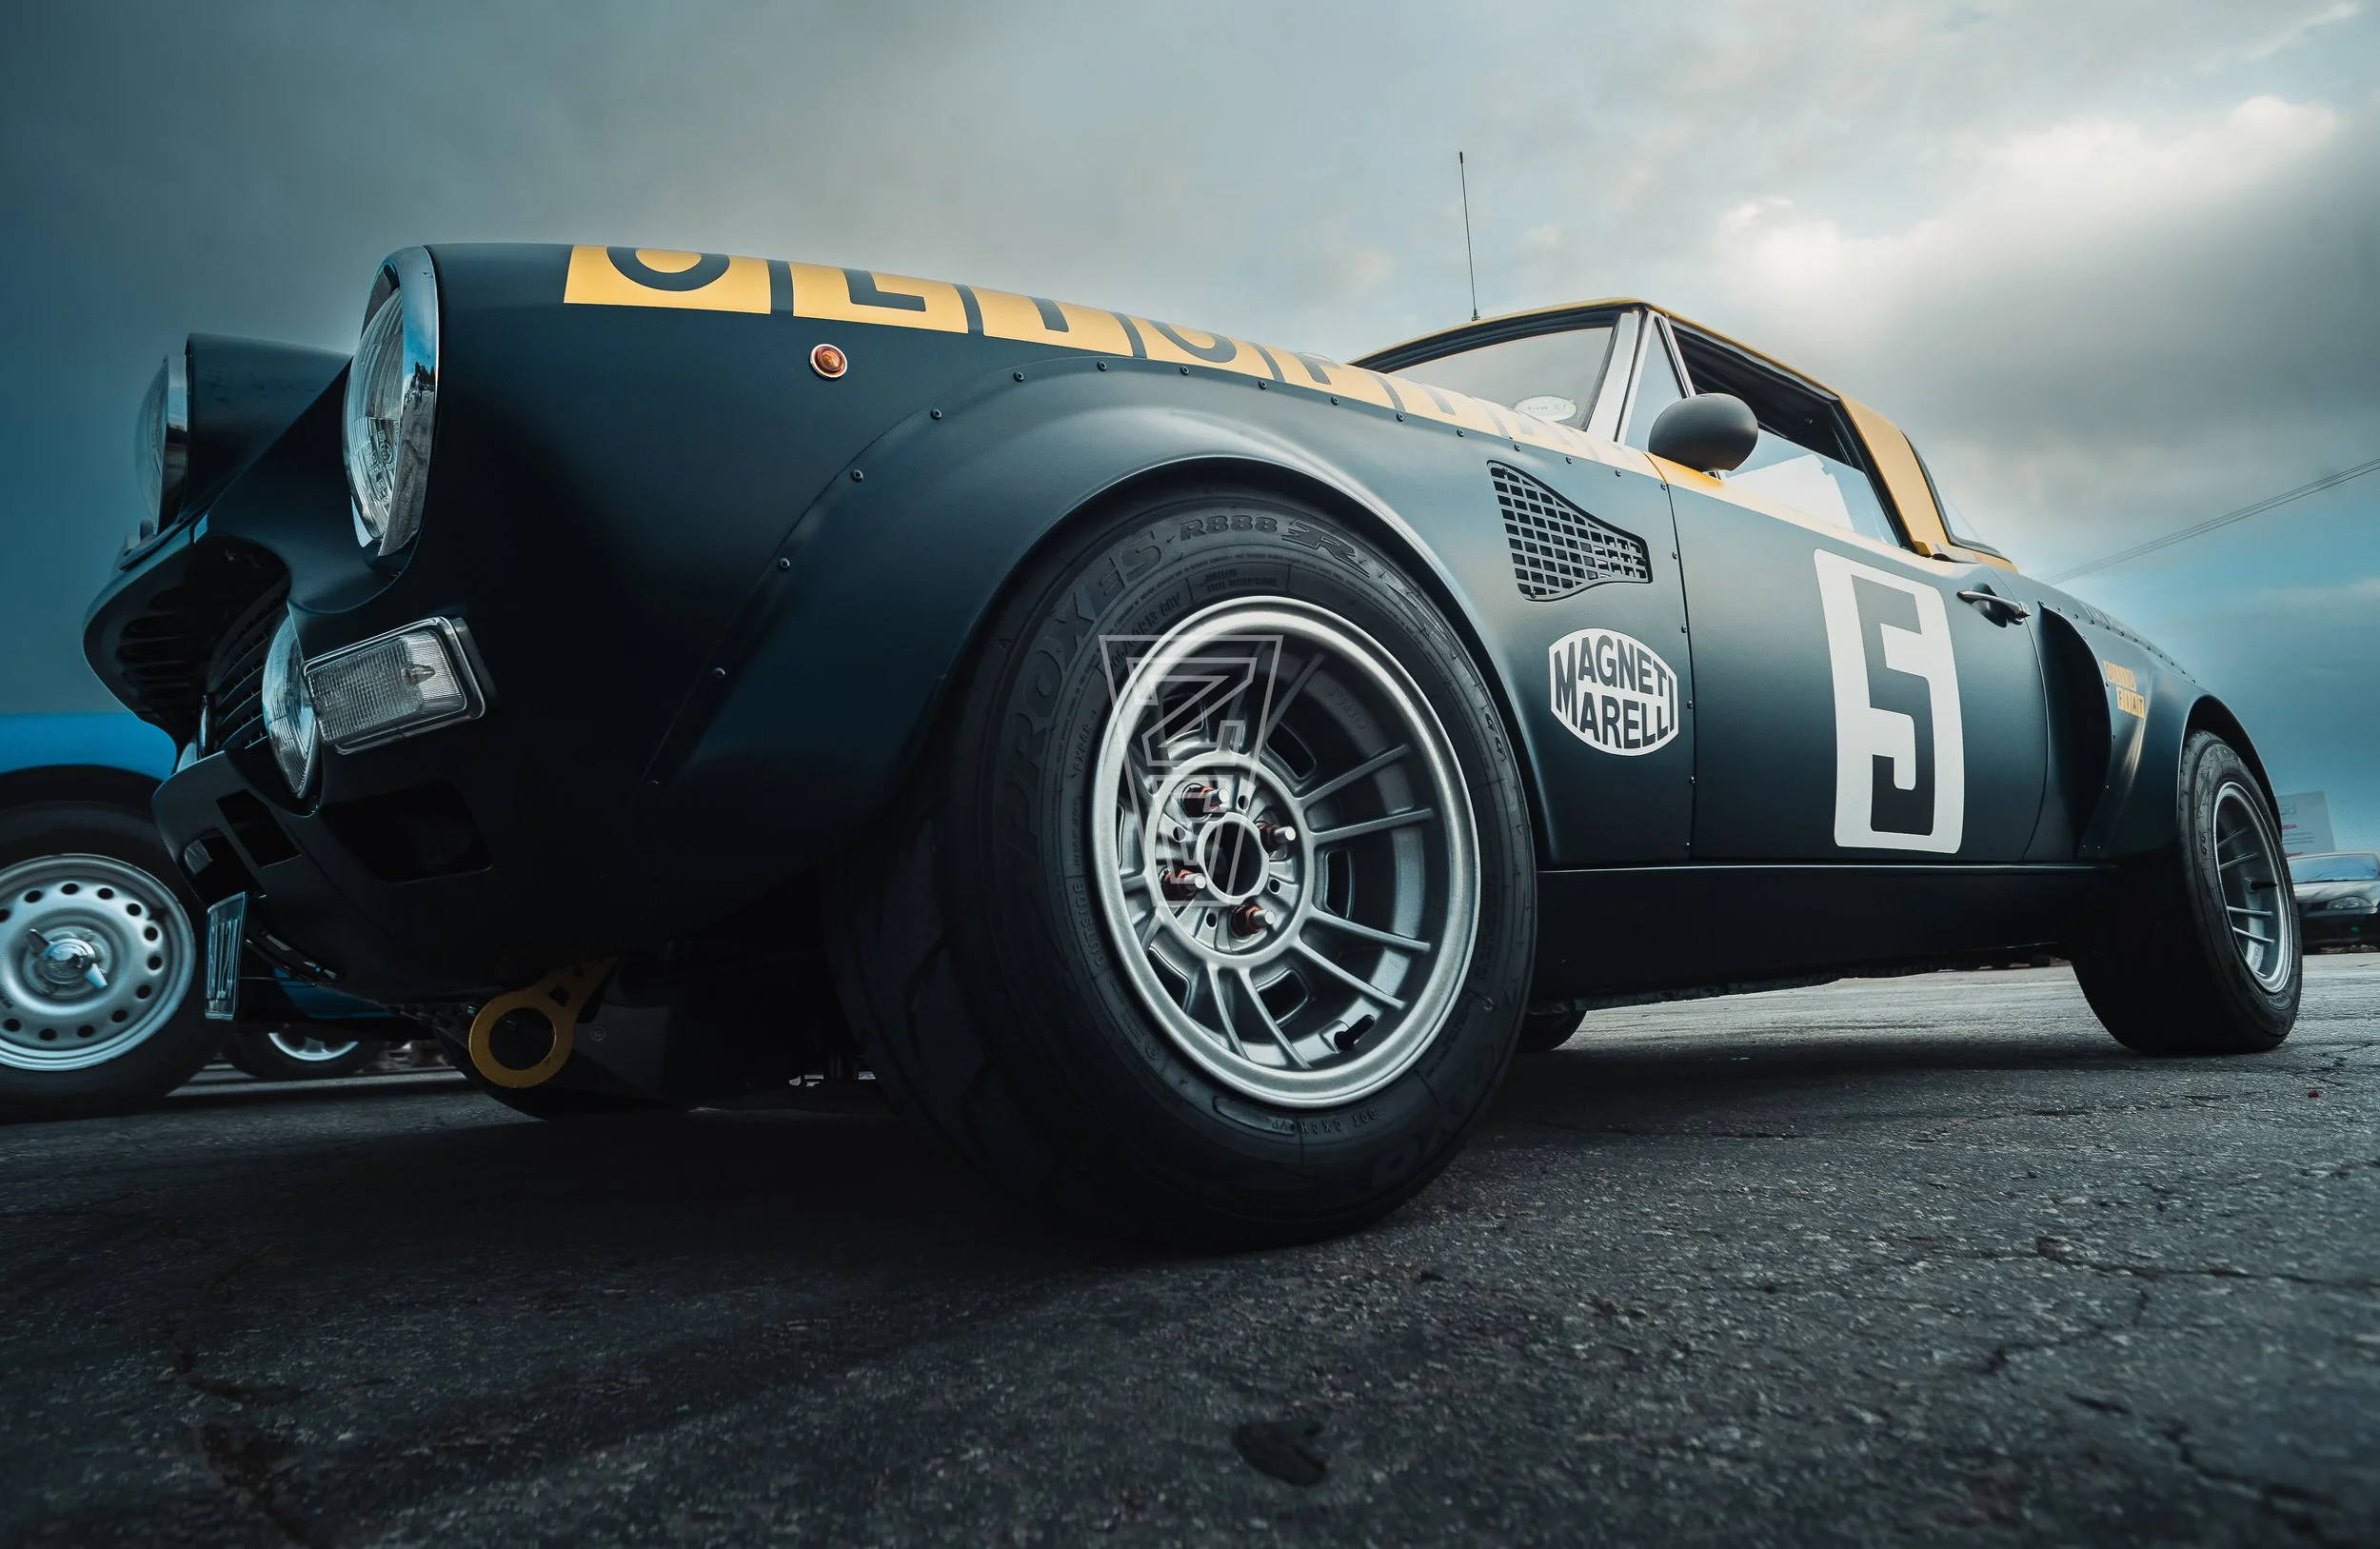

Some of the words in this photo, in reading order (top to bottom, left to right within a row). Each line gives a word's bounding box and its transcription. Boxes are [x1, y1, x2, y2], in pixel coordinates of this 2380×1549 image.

[1180, 515, 1279, 541] R888
[1002, 530, 1163, 859] PROXES
[1554, 634, 1675, 702] MAGNETI
[1556, 688, 1675, 749] MARELLI
[1851, 574, 1935, 836] 5
[2117, 687, 2144, 717] FIAT
[1072, 883, 1105, 967] OUTSIDE
[1352, 1107, 1378, 1127] DOT
